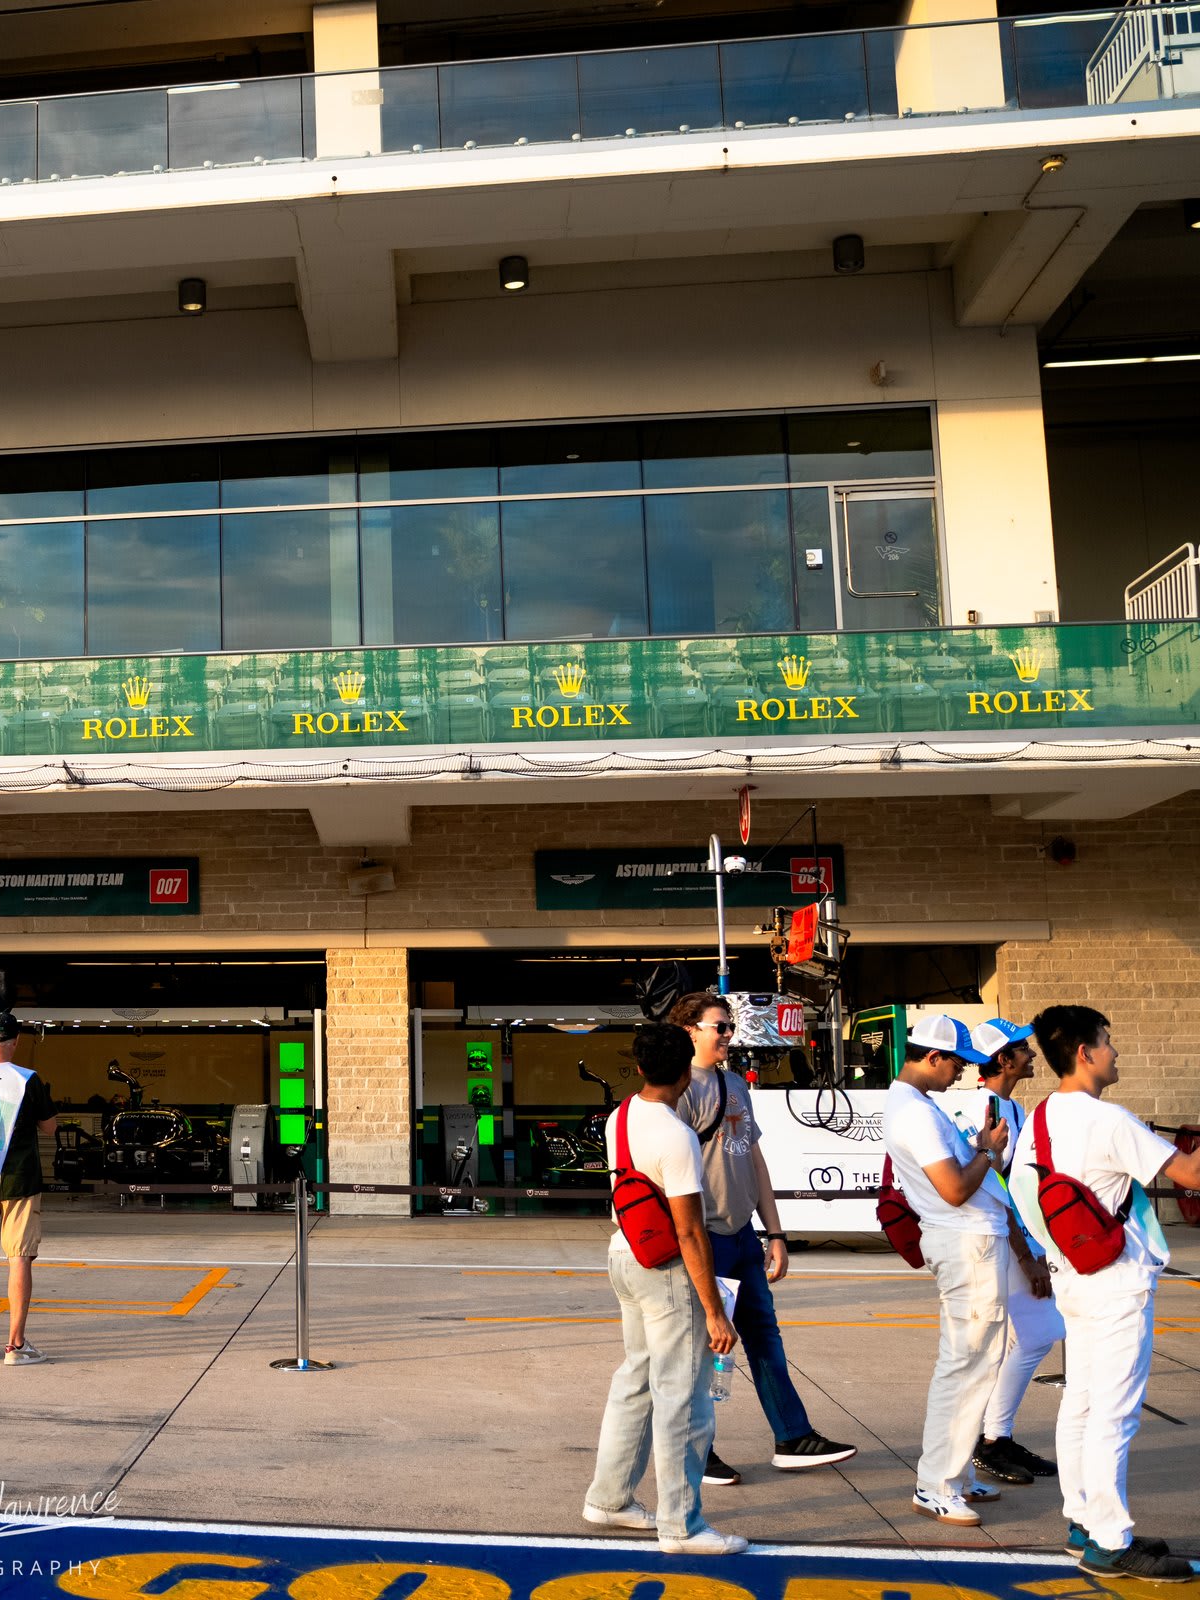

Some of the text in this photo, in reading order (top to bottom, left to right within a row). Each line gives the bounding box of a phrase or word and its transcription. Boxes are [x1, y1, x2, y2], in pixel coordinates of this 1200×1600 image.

[737, 697, 859, 721] ROLEX
[968, 689, 1093, 714] ROLEX
[83, 715, 193, 740] ROLEX
[294, 712, 408, 735] ROLEX
[512, 704, 631, 728] ROLEX
[26, 873, 65, 887] MARTIN
[66, 873, 96, 887] THOR
[96, 873, 124, 886] TEAM
[615, 864, 655, 878] ASTON
[156, 877, 182, 895] 007
[853, 1172, 880, 1183] THE
